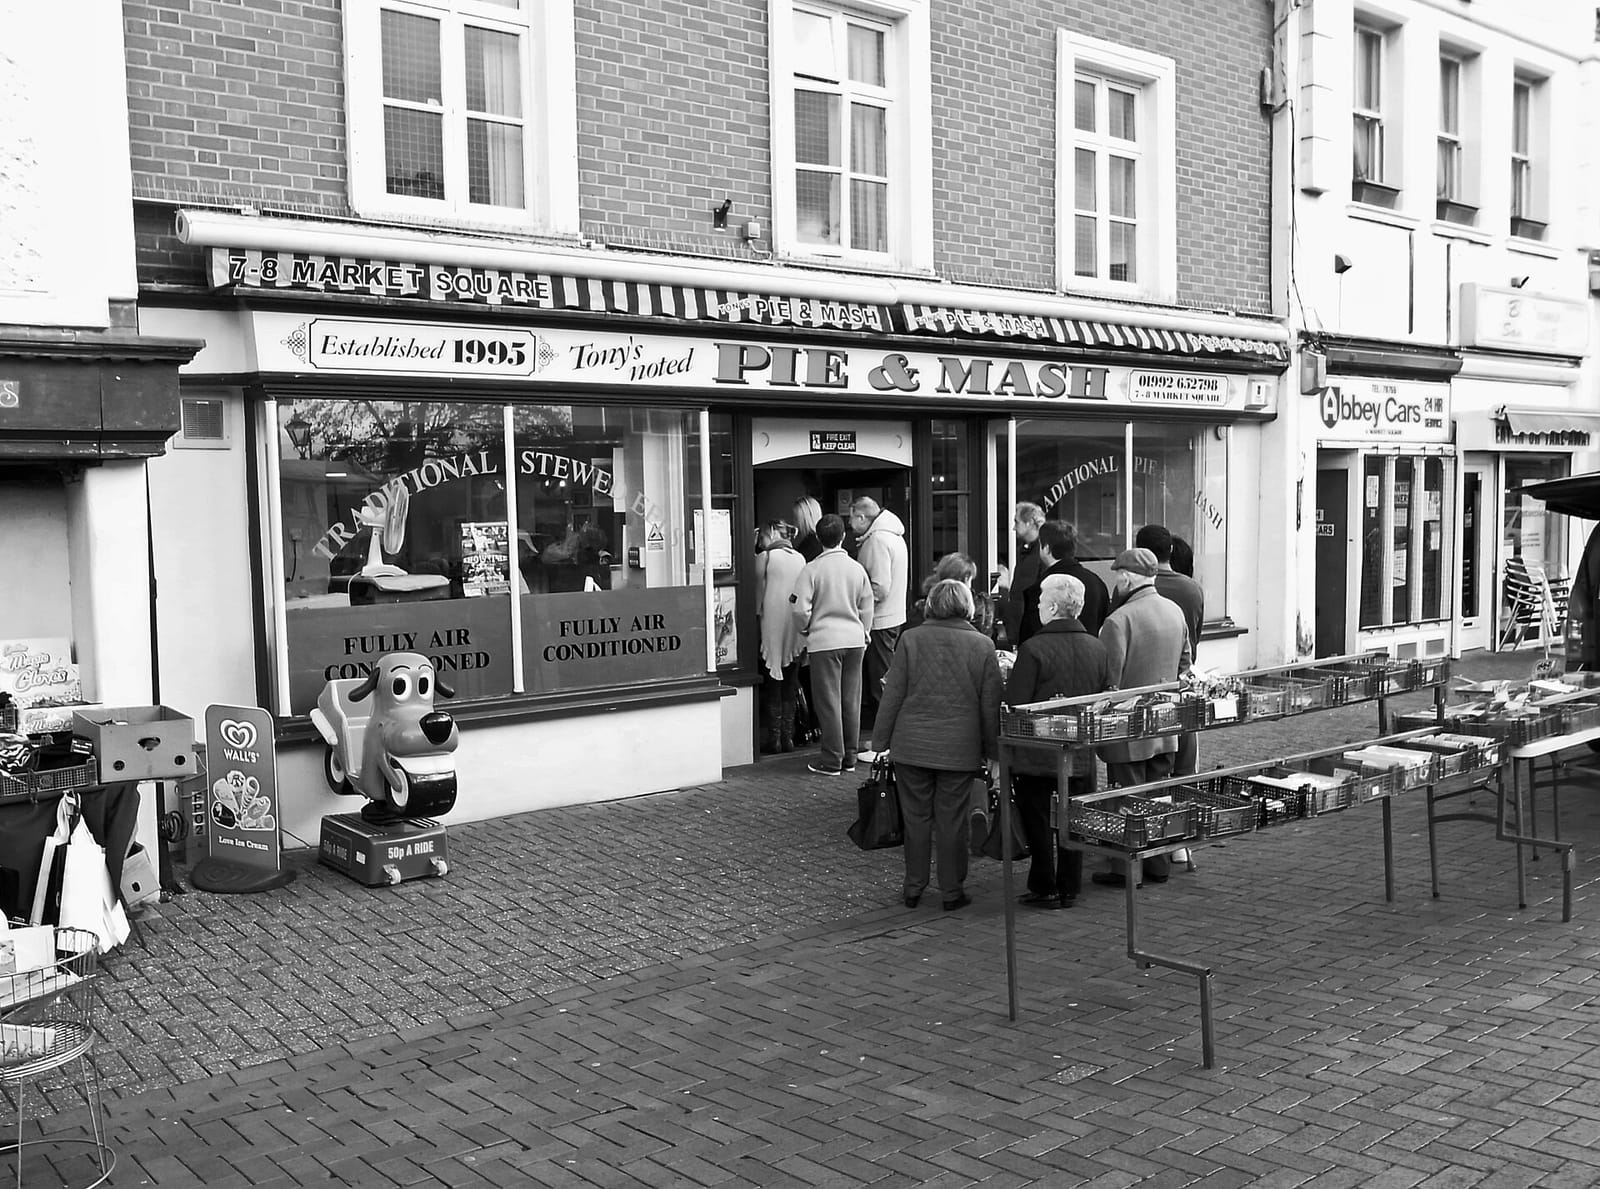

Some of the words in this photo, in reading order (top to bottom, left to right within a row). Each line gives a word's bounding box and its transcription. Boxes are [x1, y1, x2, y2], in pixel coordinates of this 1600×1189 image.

[230, 256, 278, 280] 7-8
[292, 260, 424, 291] MARKET
[436, 272, 549, 300] SQUARE
[756, 300, 790, 318] PIE
[799, 302, 812, 319] &
[821, 305, 878, 325] MASH
[946, 312, 975, 328] PIE
[982, 315, 993, 328] &
[999, 316, 1045, 335] MASH
[321, 334, 446, 359] Established
[454, 339, 526, 366] 1995
[569, 336, 644, 371] Tony's
[630, 348, 694, 381] noted
[712, 343, 848, 389] PIE
[868, 353, 920, 392] &
[935, 357, 1110, 400] MASH
[1138, 375, 1173, 389] 01992
[1176, 377, 1218, 391] 652798
[1153, 391, 1188, 401] MARKET
[1320, 386, 1381, 428] Abbey
[1385, 397, 1421, 423] Cars
[1424, 398, 1433, 412] 24
[1042, 455, 1120, 513] ADITIONAL
[560, 616, 621, 637] FULLY
[631, 614, 666, 632] AIR
[344, 632, 418, 655] FULLY
[429, 628, 471, 648] AIR
[543, 635, 682, 662] CONDITIONED
[324, 651, 491, 681] CONONED
[223, 748, 258, 763] WALL'S
[387, 846, 405, 860] 50p
[406, 844, 413, 857] A
[414, 840, 434, 856] RIDE
